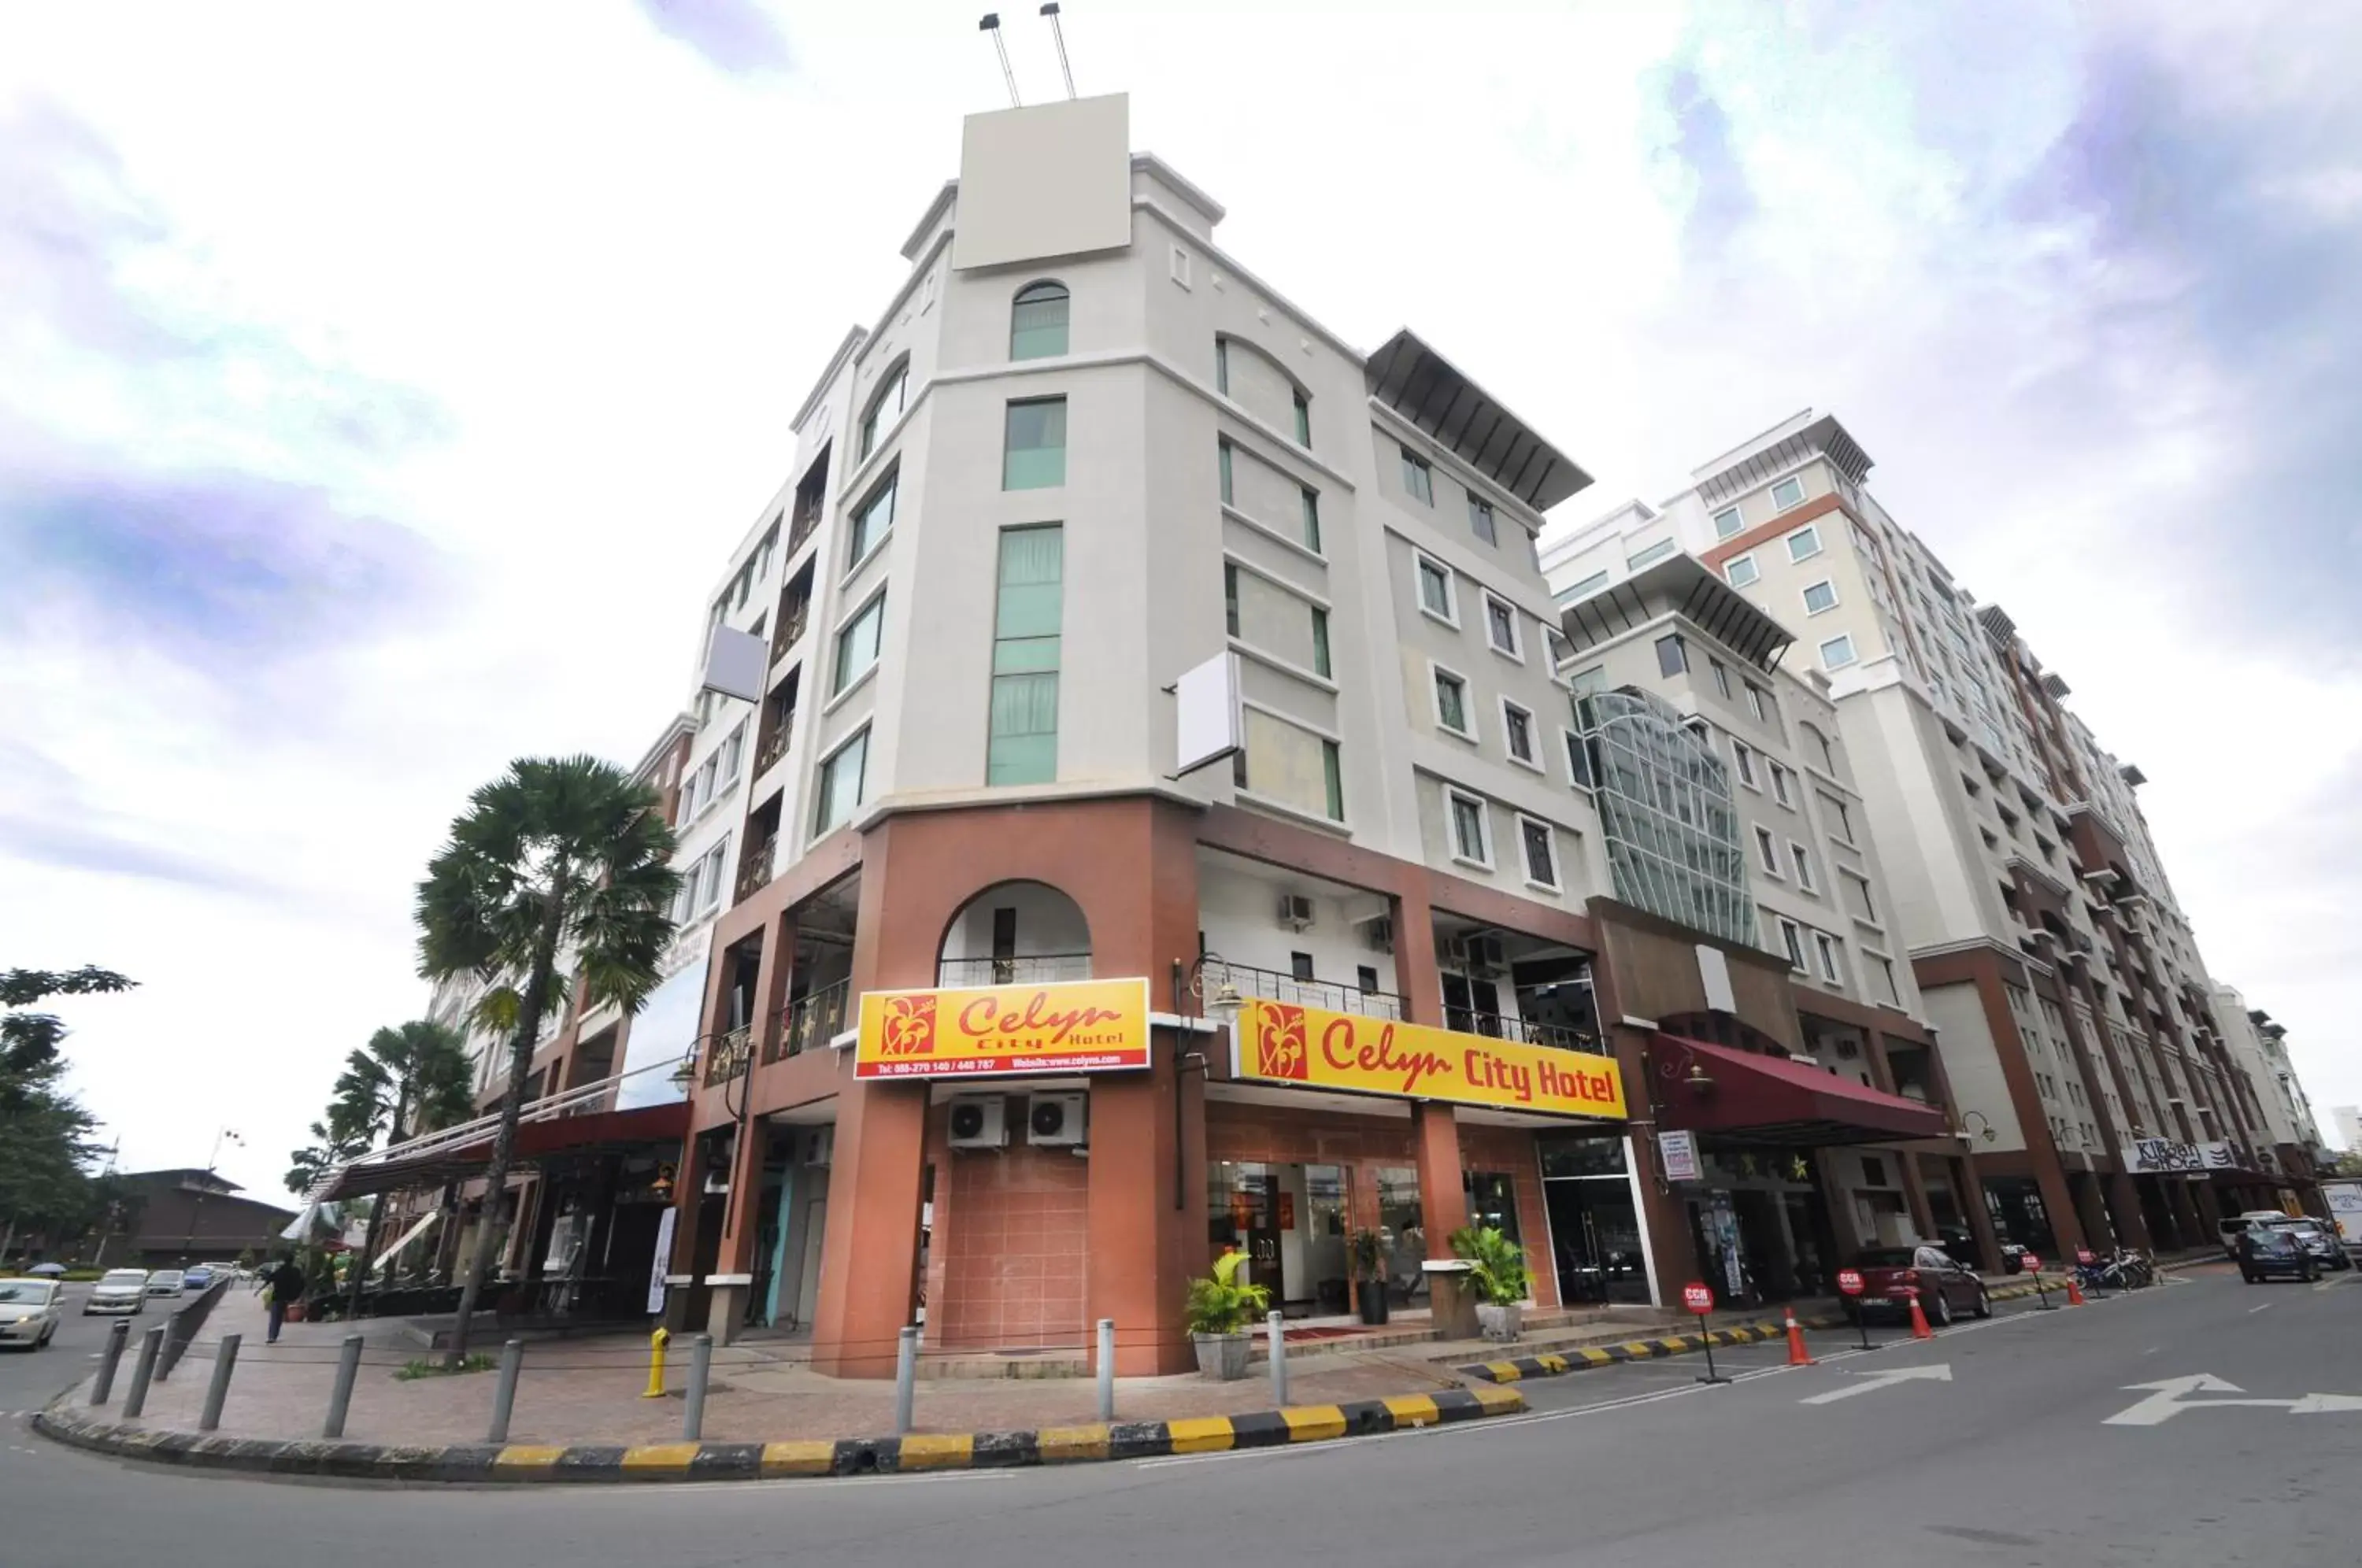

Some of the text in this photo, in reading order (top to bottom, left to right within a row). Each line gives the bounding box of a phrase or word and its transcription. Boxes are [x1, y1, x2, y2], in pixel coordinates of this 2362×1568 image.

[959, 991, 1122, 1045] Celyn
[976, 1033, 1123, 1049] City Hotel
[1322, 1018, 1616, 1103] Celyn City Hotel
